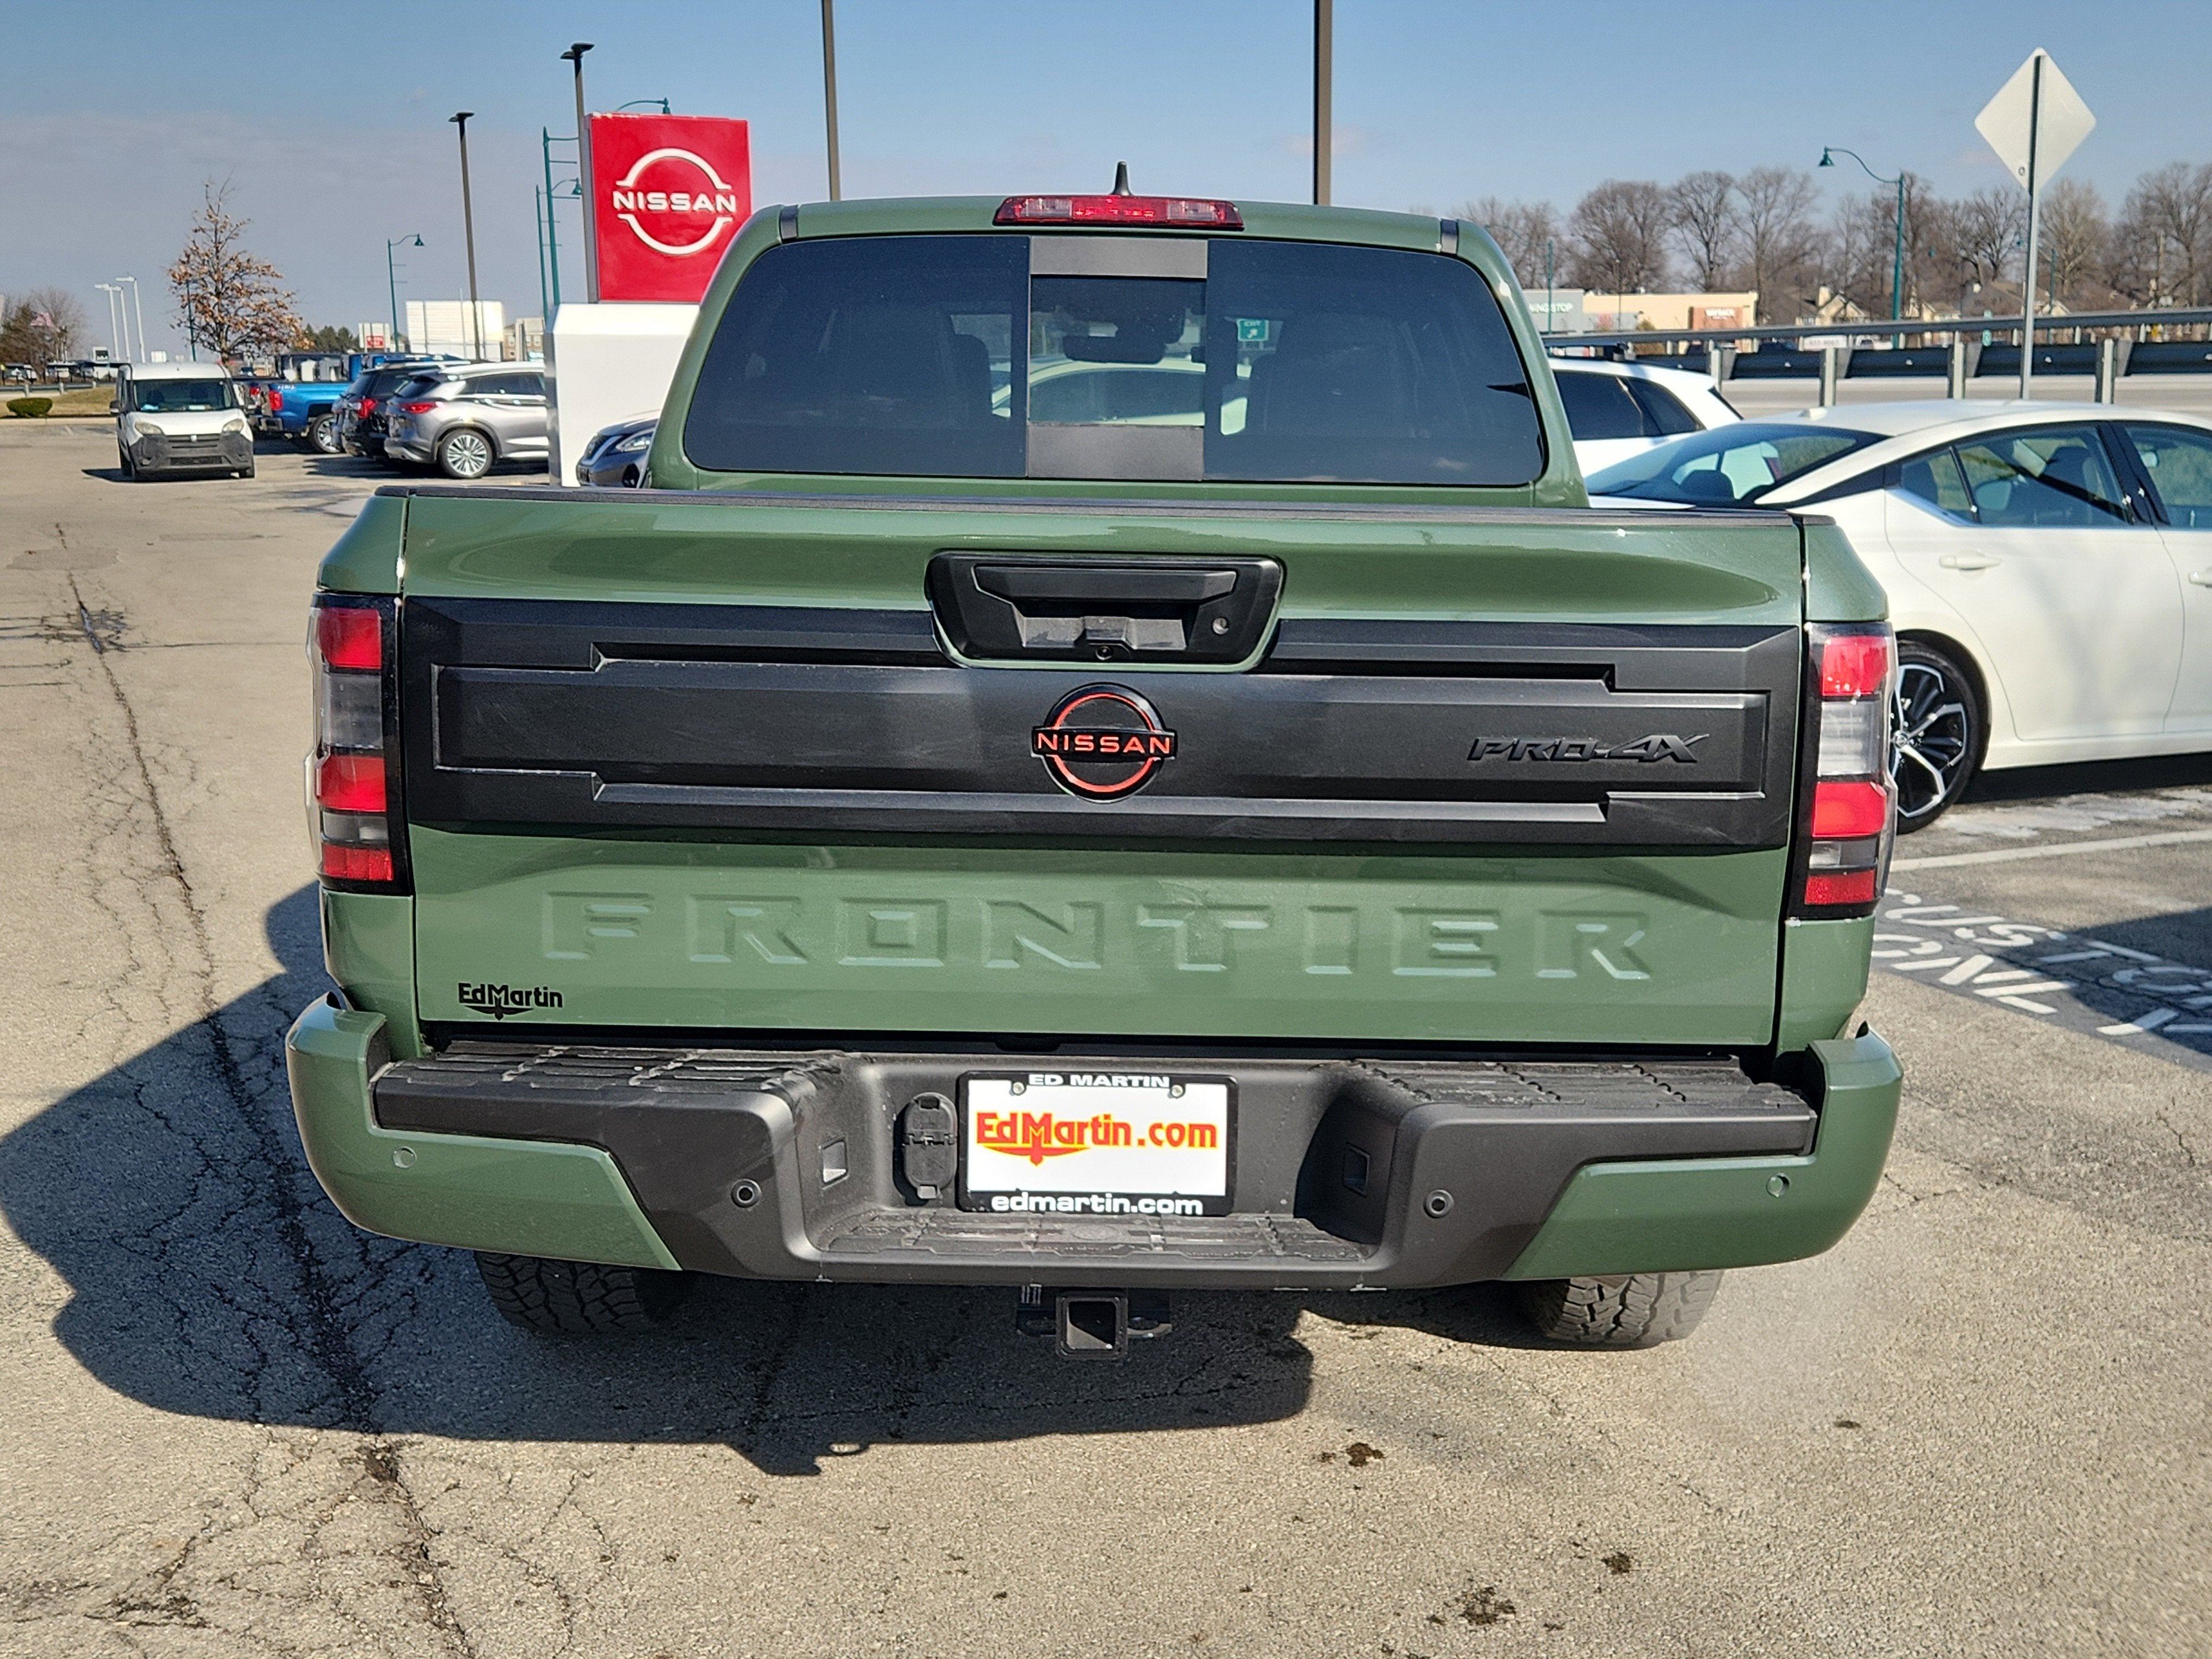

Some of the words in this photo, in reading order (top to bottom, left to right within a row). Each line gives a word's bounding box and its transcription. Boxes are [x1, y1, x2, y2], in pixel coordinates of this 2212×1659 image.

[613, 190, 737, 214] NISSAN
[1038, 732, 1171, 755] NISSAN
[1467, 733, 1710, 763] PRO-4X
[542, 891, 1651, 980] FRONTIER
[458, 982, 563, 1008] EdMartin
[1028, 1074, 1064, 1086] ED
[1070, 1075, 1170, 1089] MARTIN
[992, 1192, 1204, 1216] edmartin.com
